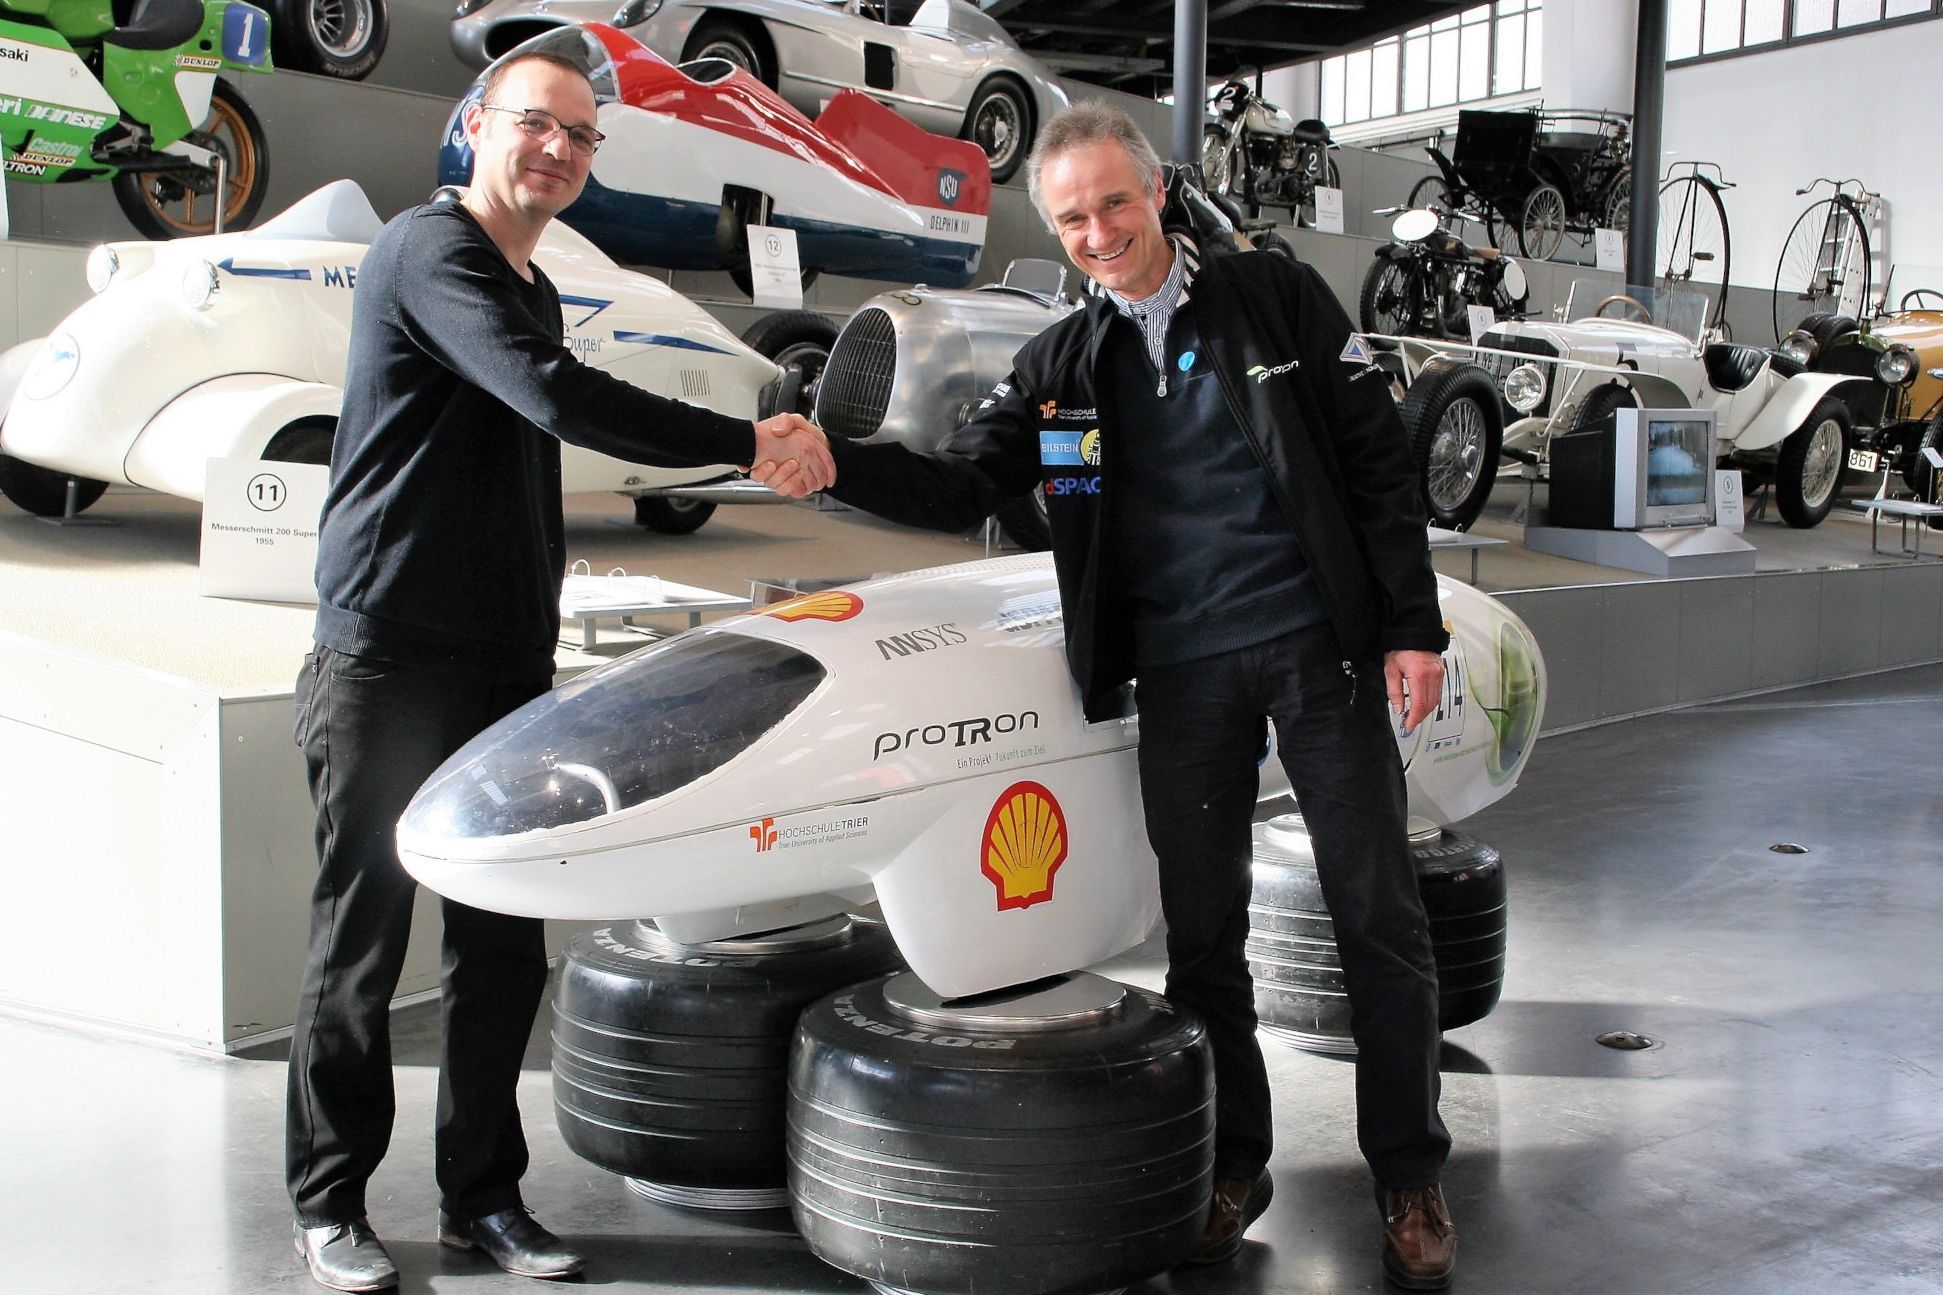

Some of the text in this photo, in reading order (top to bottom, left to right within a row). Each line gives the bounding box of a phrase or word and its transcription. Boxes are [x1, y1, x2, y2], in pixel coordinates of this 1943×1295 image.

[238, 13, 253, 57] 1
[183, 58, 220, 67] DUNLOP
[1220, 87, 1236, 101] 2
[24, 153, 73, 164] DUNLOP
[1309, 153, 1317, 171] 2
[940, 174, 958, 199] NSU
[930, 215, 969, 233] DELPHIN III
[768, 241, 779, 251] 12
[323, 266, 357, 288] ME
[1041, 443, 1080, 453] BILSTEIN
[1849, 452, 1873, 469] 861
[255, 483, 278, 502] 11
[211, 522, 318, 538] Messerschmitt 200 Super
[255, 537, 274, 546] 1955
[875, 623, 967, 661] ANSYS
[957, 758, 968, 769] Ein
[969, 753, 992, 768] Projekt
[841, 816, 869, 830] TRIER
[834, 993, 1017, 1050] POTENZA
